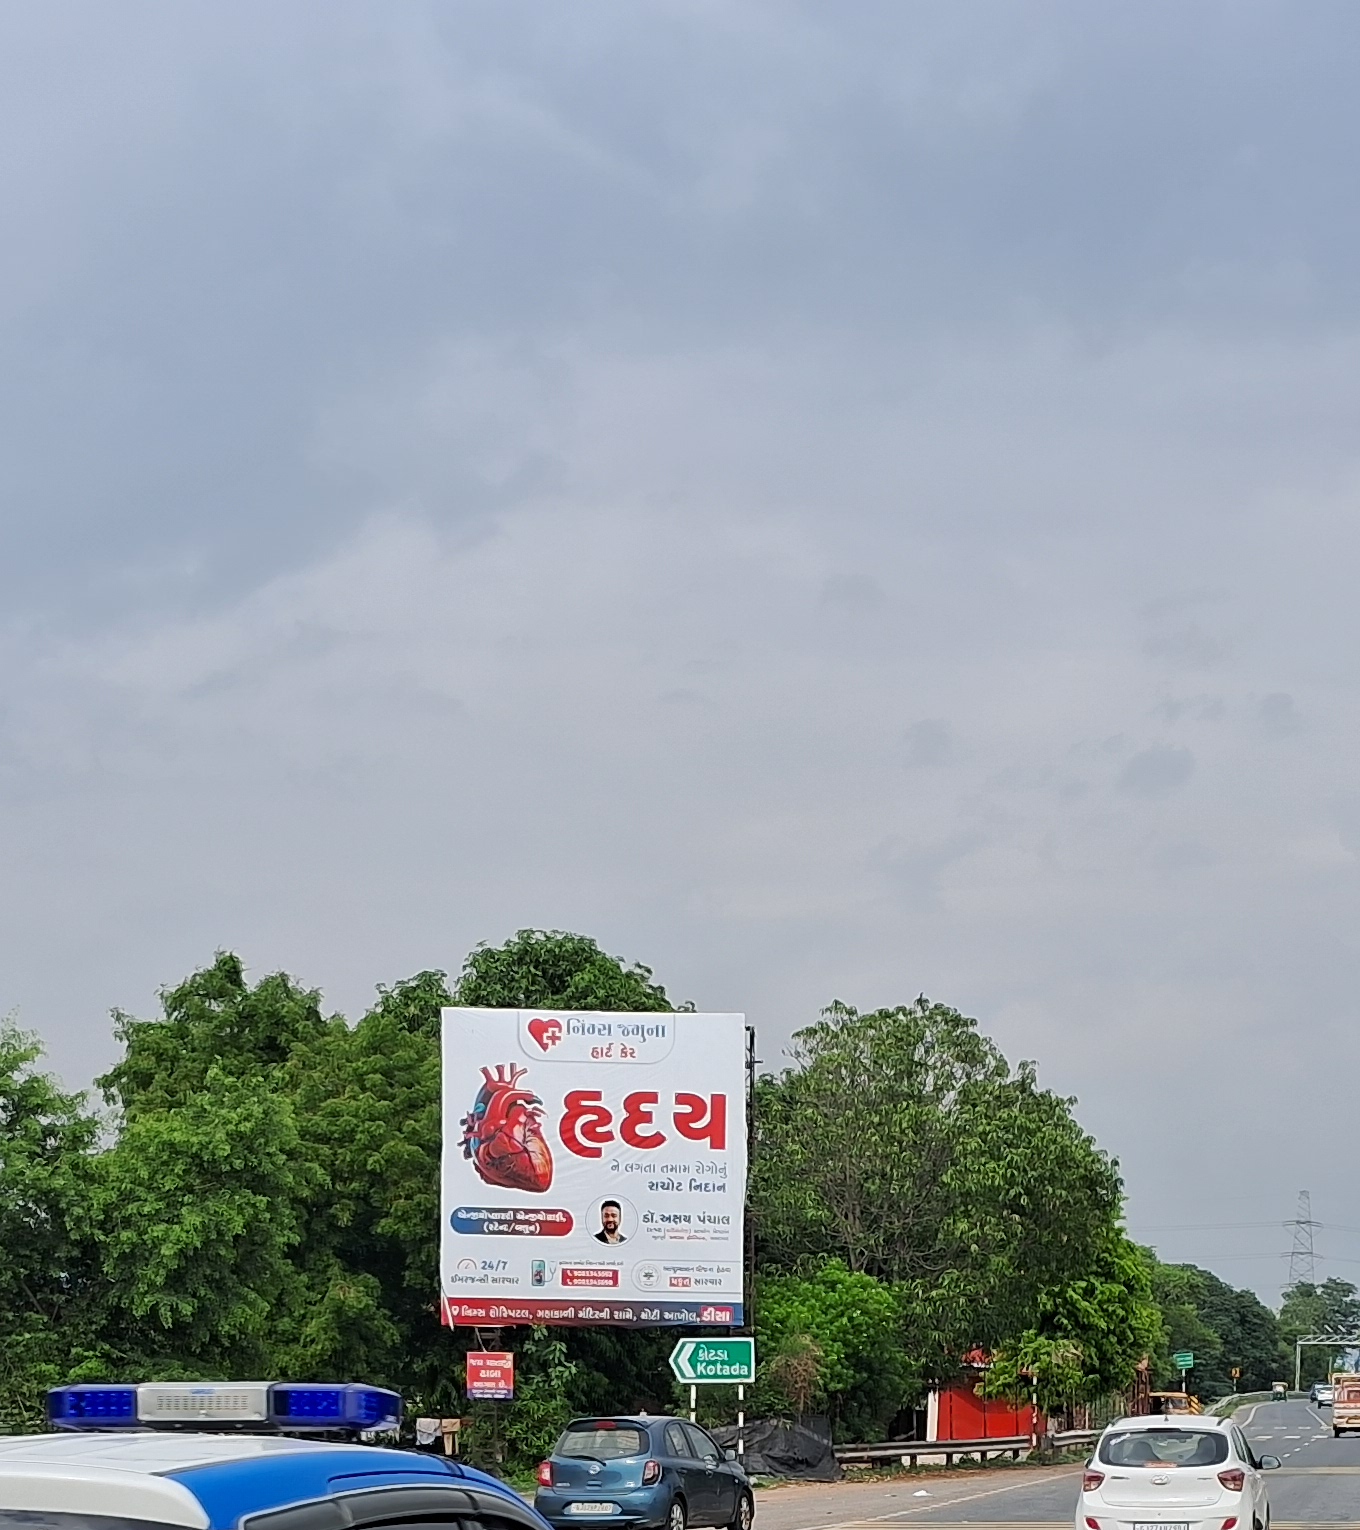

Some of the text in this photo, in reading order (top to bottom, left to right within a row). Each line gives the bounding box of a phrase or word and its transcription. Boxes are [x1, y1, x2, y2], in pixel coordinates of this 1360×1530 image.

[590, 1042, 636, 1059] હાર્ટ કેર
[558, 1089, 727, 1159] હૃદય
[610, 1159, 728, 1179] ને લગતા તમામ રોગોનું
[648, 1177, 727, 1193] સચોટ નિદાન
[696, 1210, 731, 1225] પંચાલ
[481, 1259, 508, 1272] 24/7
[490, 1276, 520, 1285] સારવાર
[693, 1277, 723, 1286] સારવાર
[702, 1306, 731, 1322] ડીસા
[697, 1344, 729, 1361] કોટડા
[697, 1362, 749, 1376] Kotada
